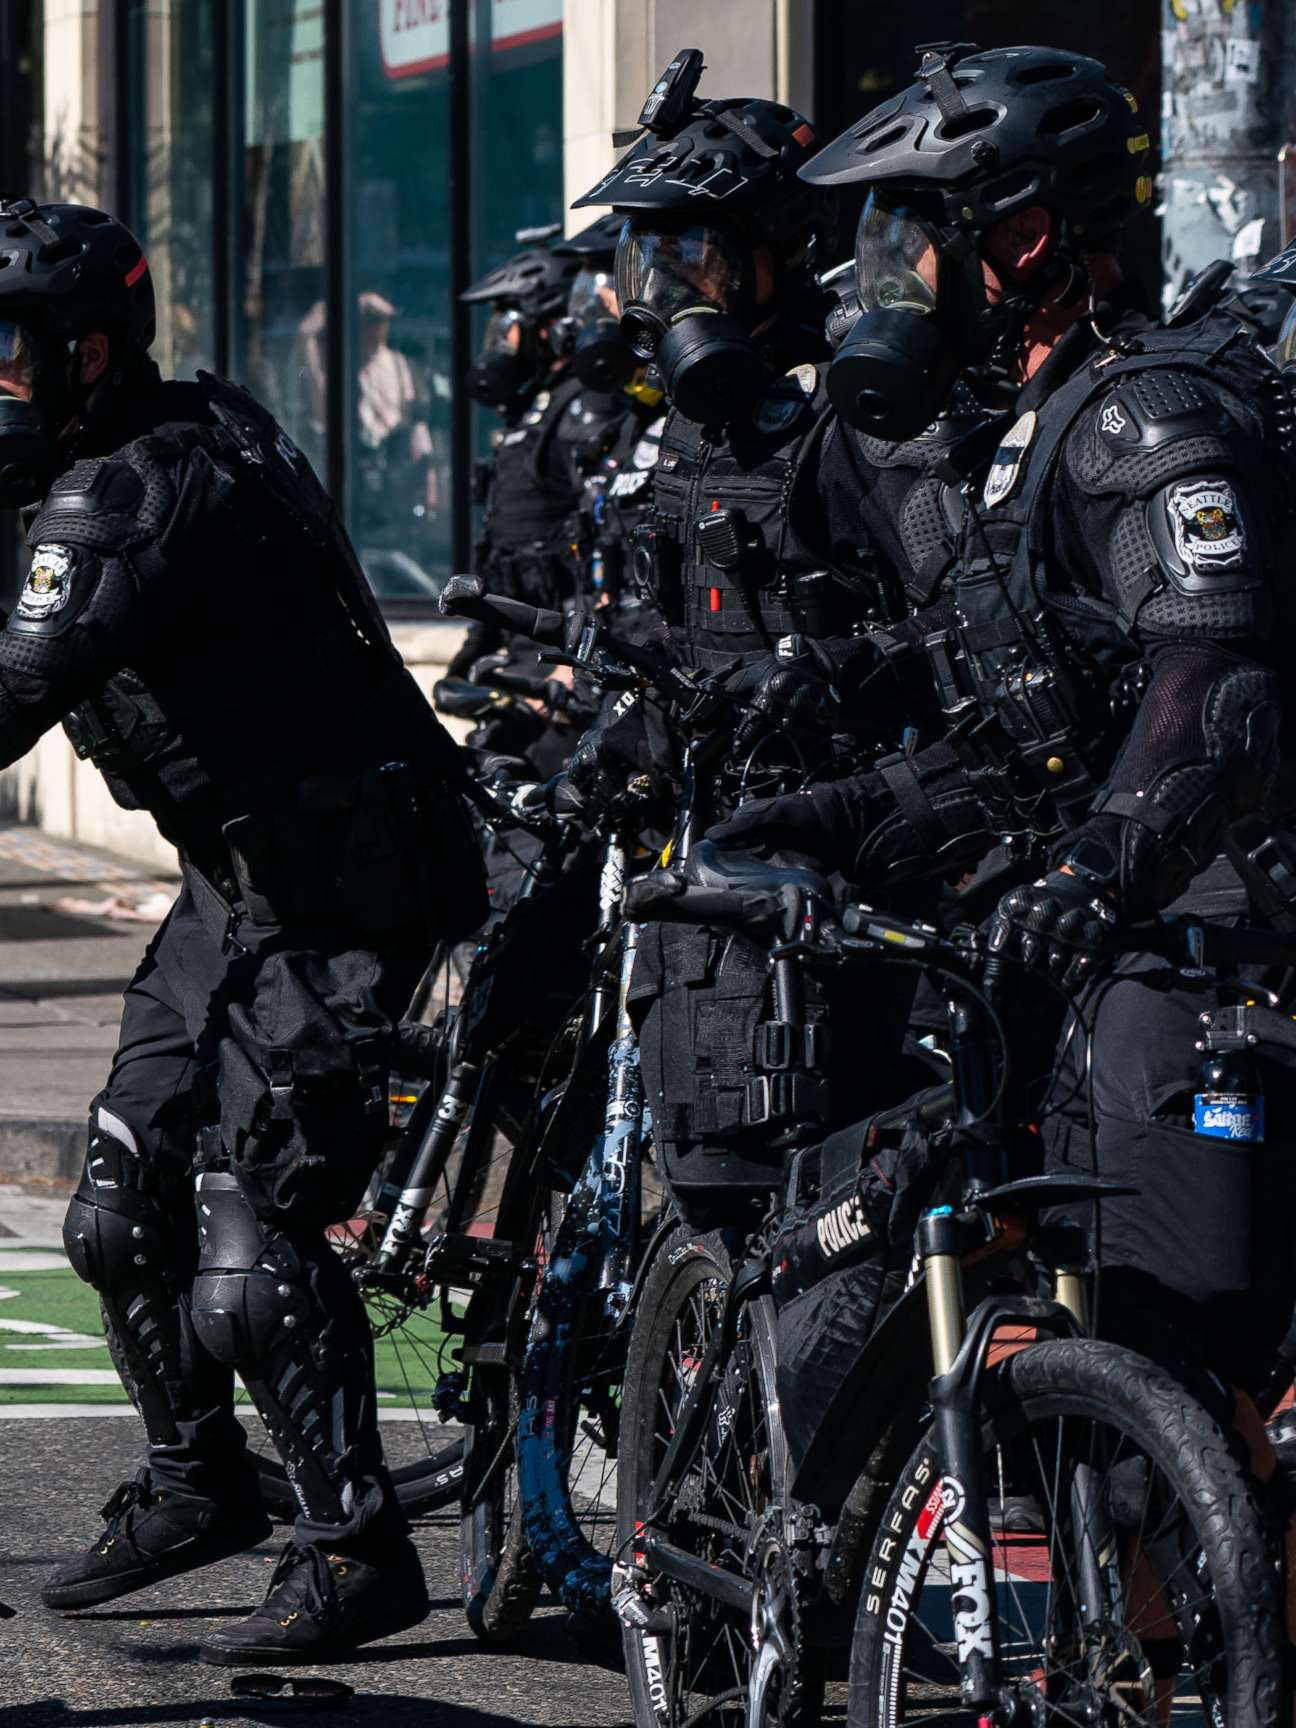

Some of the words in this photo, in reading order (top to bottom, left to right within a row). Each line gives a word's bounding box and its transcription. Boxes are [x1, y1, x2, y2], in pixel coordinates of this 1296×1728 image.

[1181, 494, 1233, 512] SEATTLE
[1195, 539, 1241, 551] POLICE
[816, 1195, 871, 1257] POLICE
[867, 1462, 932, 1616] SERFAS
[883, 1525, 931, 1646] XM401
[951, 1558, 994, 1664] FOX
[641, 1630, 669, 1711] M401
